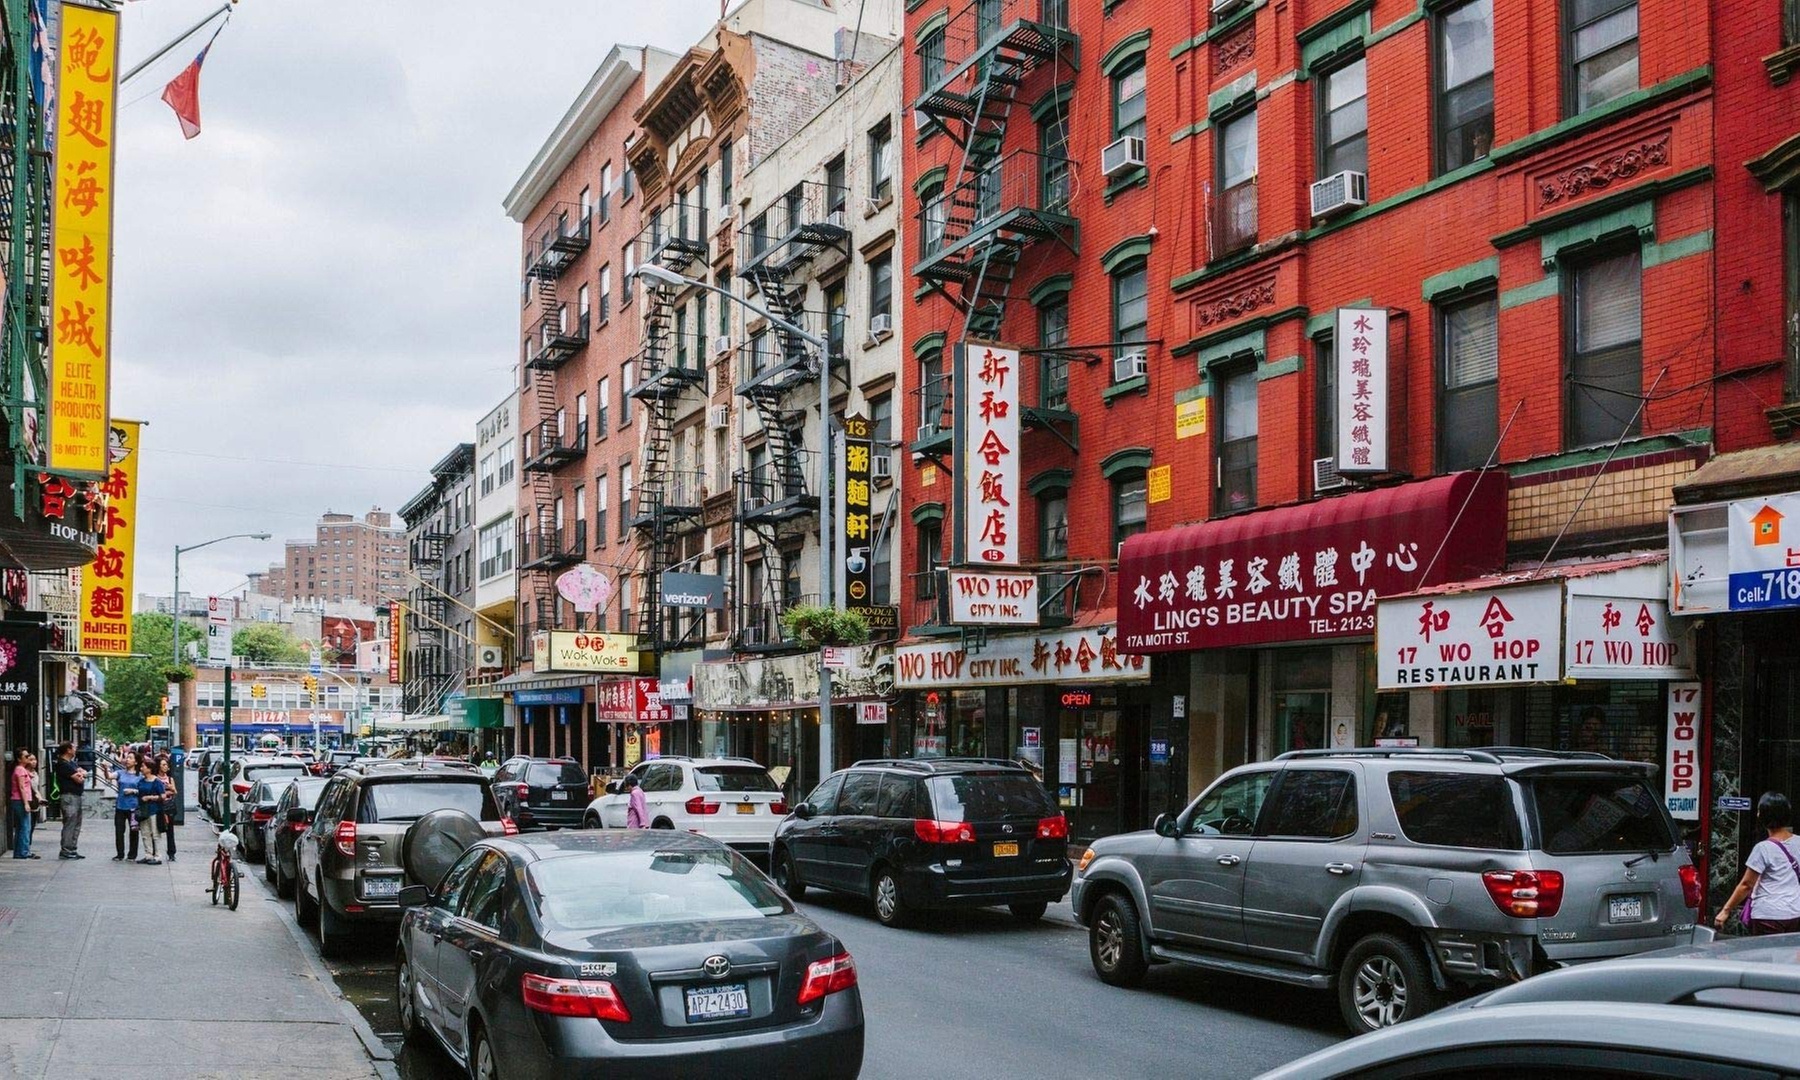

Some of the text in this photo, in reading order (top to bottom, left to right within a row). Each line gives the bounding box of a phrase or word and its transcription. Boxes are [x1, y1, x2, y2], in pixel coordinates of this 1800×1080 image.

[56, 26, 110, 358] 鮑翅海味城
[66, 362, 91, 379] ELITE
[61, 381, 96, 399] HEALTH
[54, 401, 102, 420] PRODUCTS
[70, 422, 87, 438] INC.
[847, 420, 866, 436] 13
[55, 444, 100, 457] 18 MOTT ST
[977, 349, 1010, 547] 新和合飯店
[50, 522, 78, 541] HOP
[987, 551, 998, 561] 15
[957, 577, 1034, 600] WO HOP
[665, 592, 708, 605] verizon
[970, 603, 1021, 618] CITY INC.
[1154, 589, 1376, 632] LING'S BEAUTY SPA
[1309, 618, 1337, 634] TEL:
[1418, 595, 1515, 644] 和合
[1602, 602, 1655, 637] 和合
[84, 622, 127, 635] AJISEN
[84, 638, 127, 651] RAMEN
[1126, 631, 1190, 648] 17A MOTT ST.
[561, 649, 588, 661] Wok
[590, 655, 617, 666] Wok
[1398, 639, 1540, 665] 17 WO HOP
[1575, 640, 1679, 666] 17 WO HOP
[898, 649, 1024, 681] WO HOP CITY INC.
[1397, 663, 1539, 684] RESTAURANT
[1062, 693, 1091, 705] OPEN
[1672, 689, 1699, 703] 17
[254, 711, 289, 722] PIZZA
[864, 705, 877, 721] ATM
[1674, 712, 1696, 741] WO
[1672, 750, 1694, 793] HOP
